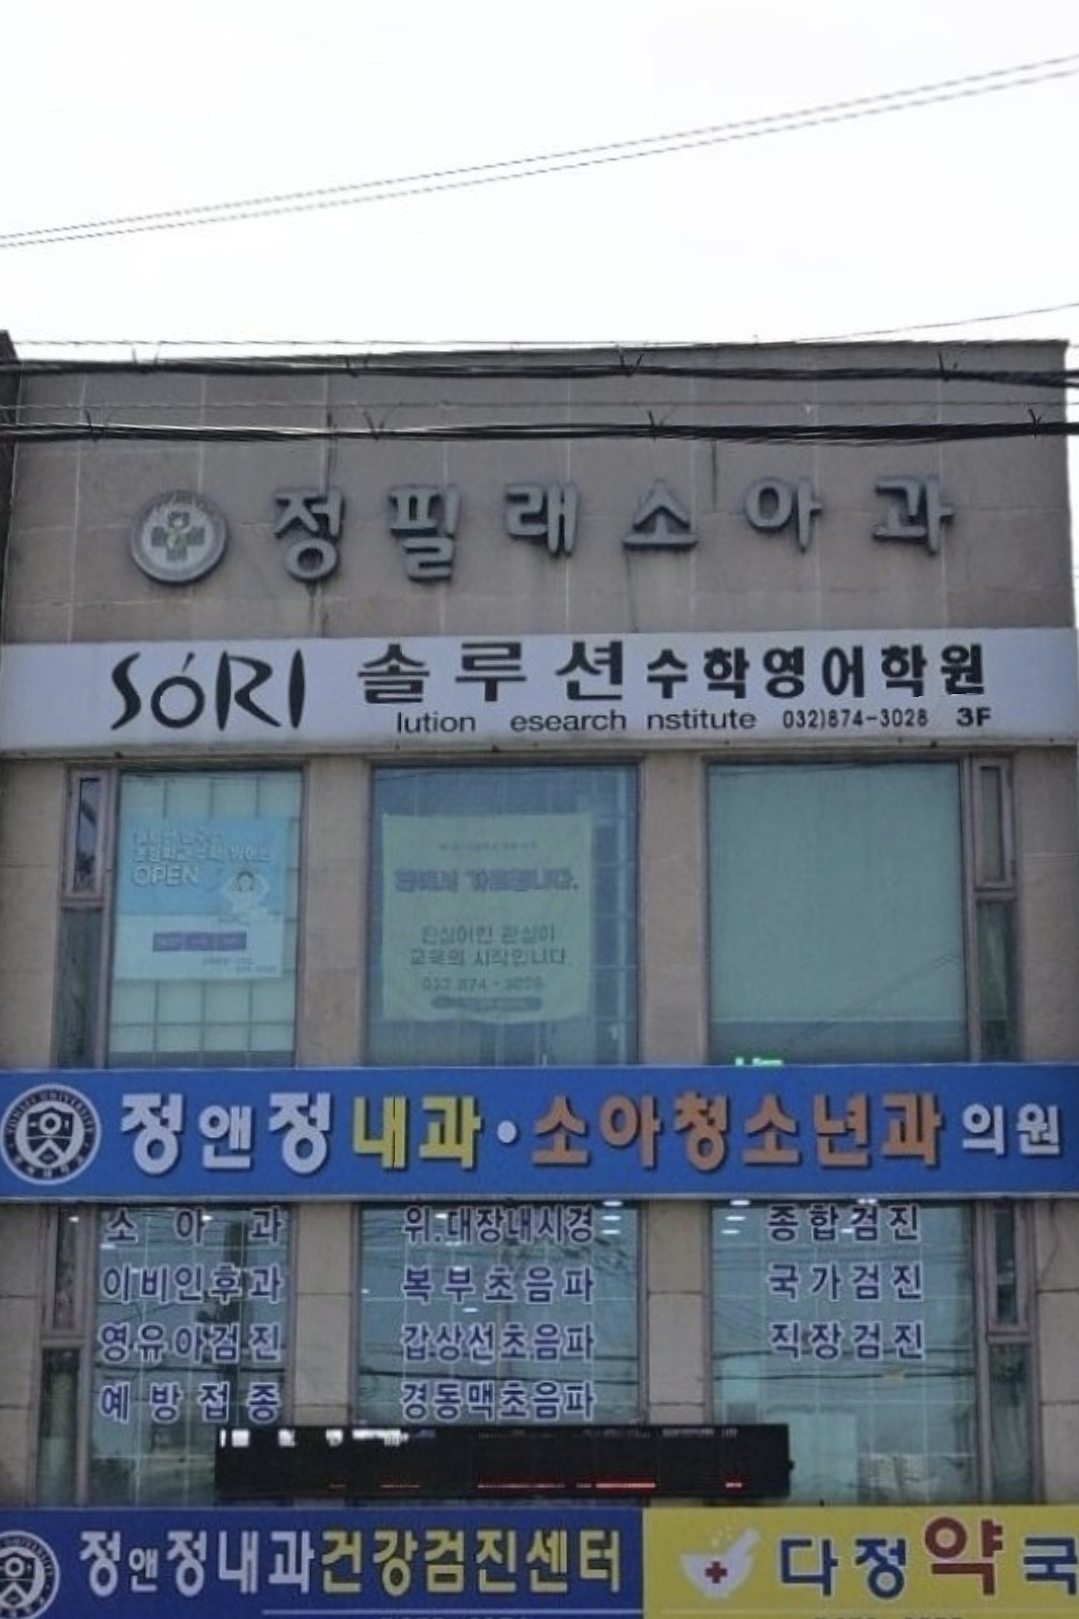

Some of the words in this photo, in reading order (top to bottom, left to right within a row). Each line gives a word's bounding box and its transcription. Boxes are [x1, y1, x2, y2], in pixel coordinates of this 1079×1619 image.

[397, 712, 476, 733] lution
[510, 709, 627, 733] esearch
[646, 708, 757, 730] nstitute
[782, 708, 929, 729] 032)874-3028
[955, 706, 992, 727] 3F
[131, 864, 200, 888] OPEN
[766, 1204, 922, 1243] 종합검진
[102, 1263, 284, 1304] 이비인후과
[402, 1265, 595, 1304] 복부초음파
[768, 1262, 924, 1302] 국가검진
[99, 1322, 283, 1363] 영유아검진
[402, 1322, 596, 1362] 갑상선초음파
[769, 1321, 926, 1362] 직장검진
[99, 1381, 281, 1424] 예방접종
[401, 1381, 596, 1421] 경동맥초음파
